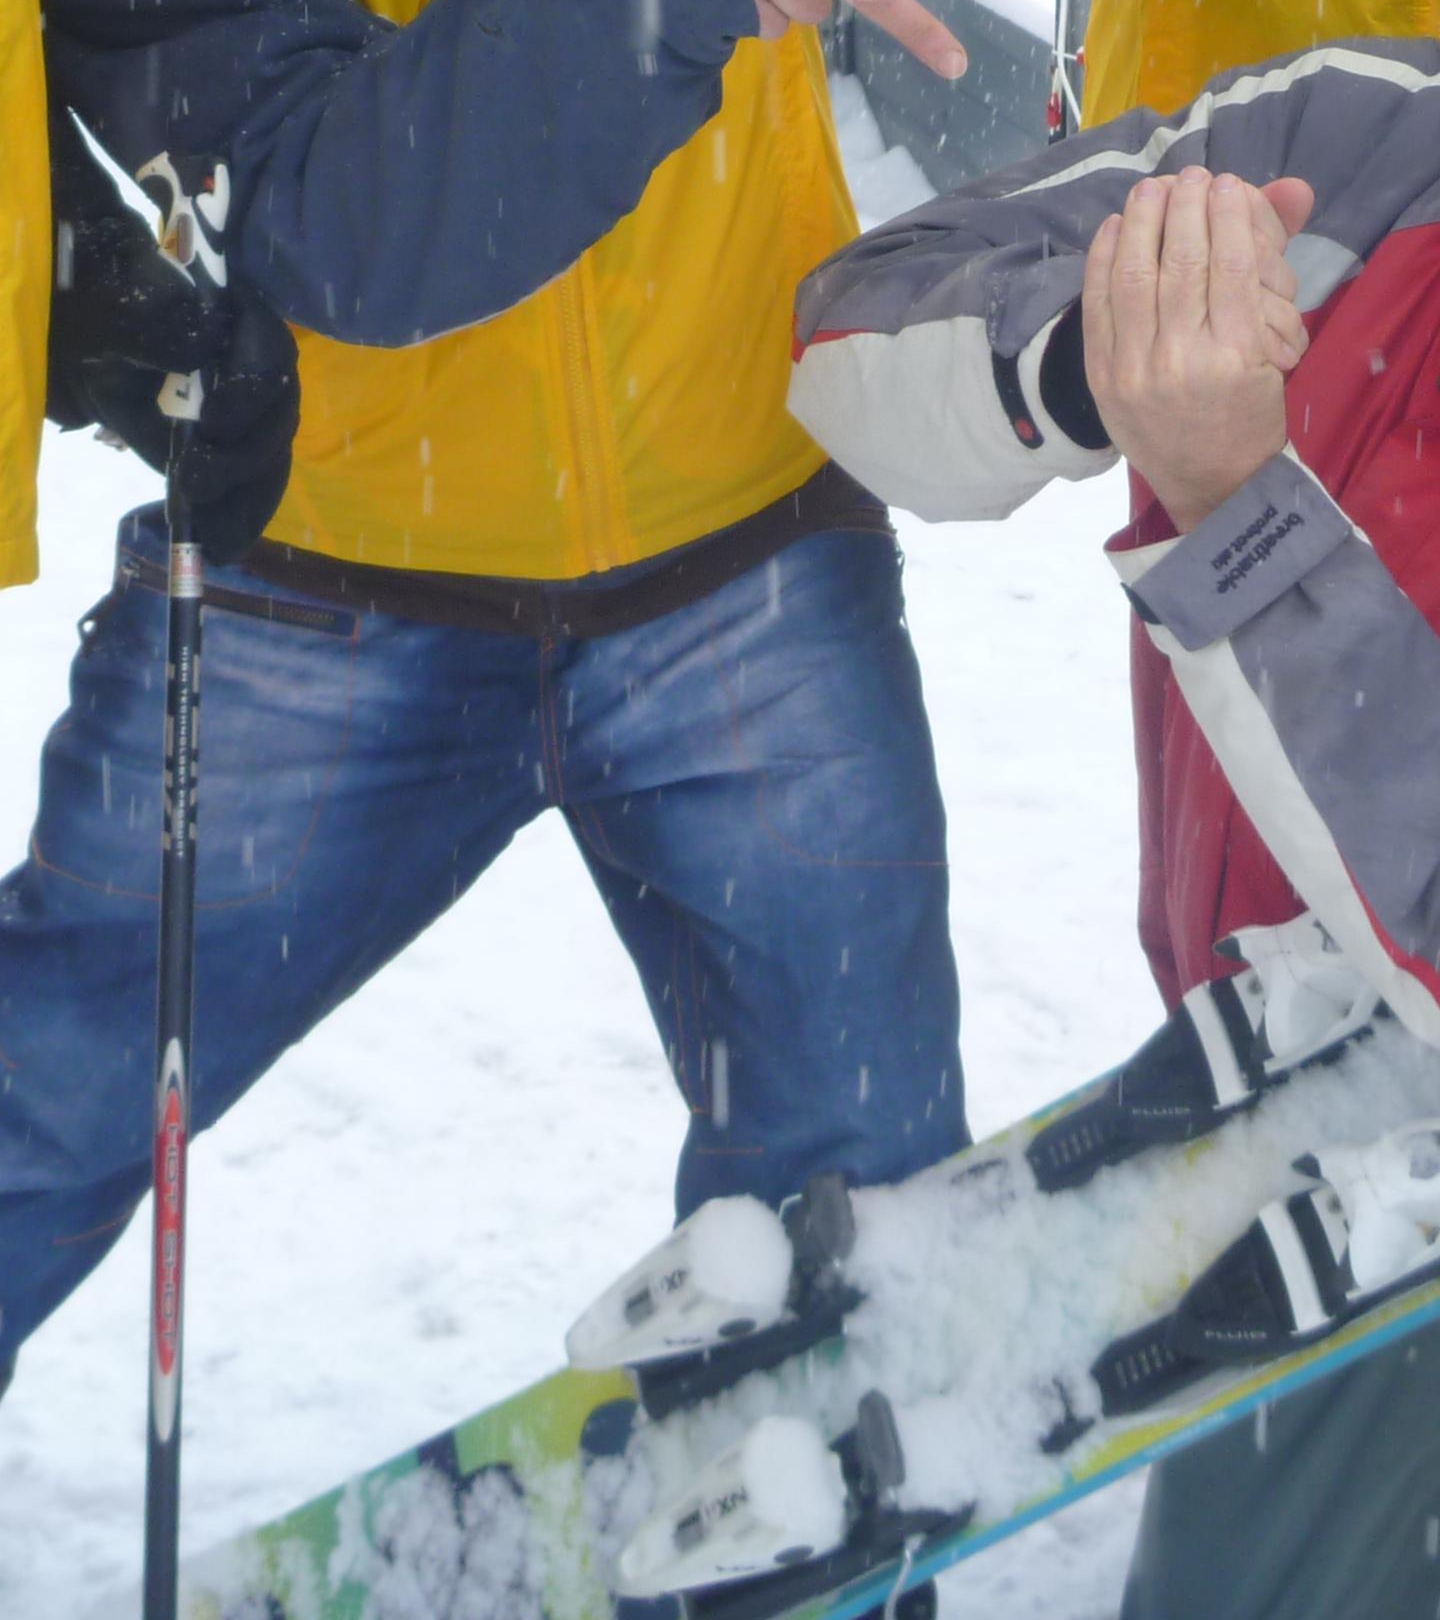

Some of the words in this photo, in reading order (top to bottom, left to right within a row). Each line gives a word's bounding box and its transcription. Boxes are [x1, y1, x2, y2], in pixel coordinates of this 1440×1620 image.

[1213, 511, 1306, 595] breathable
[180, 645, 189, 682] HIGH
[178, 686, 189, 784] TECHNOLOGY
[176, 788, 186, 858] PRODUCT
[165, 1122, 180, 1208] HOT
[162, 1229, 178, 1342] SHOT
